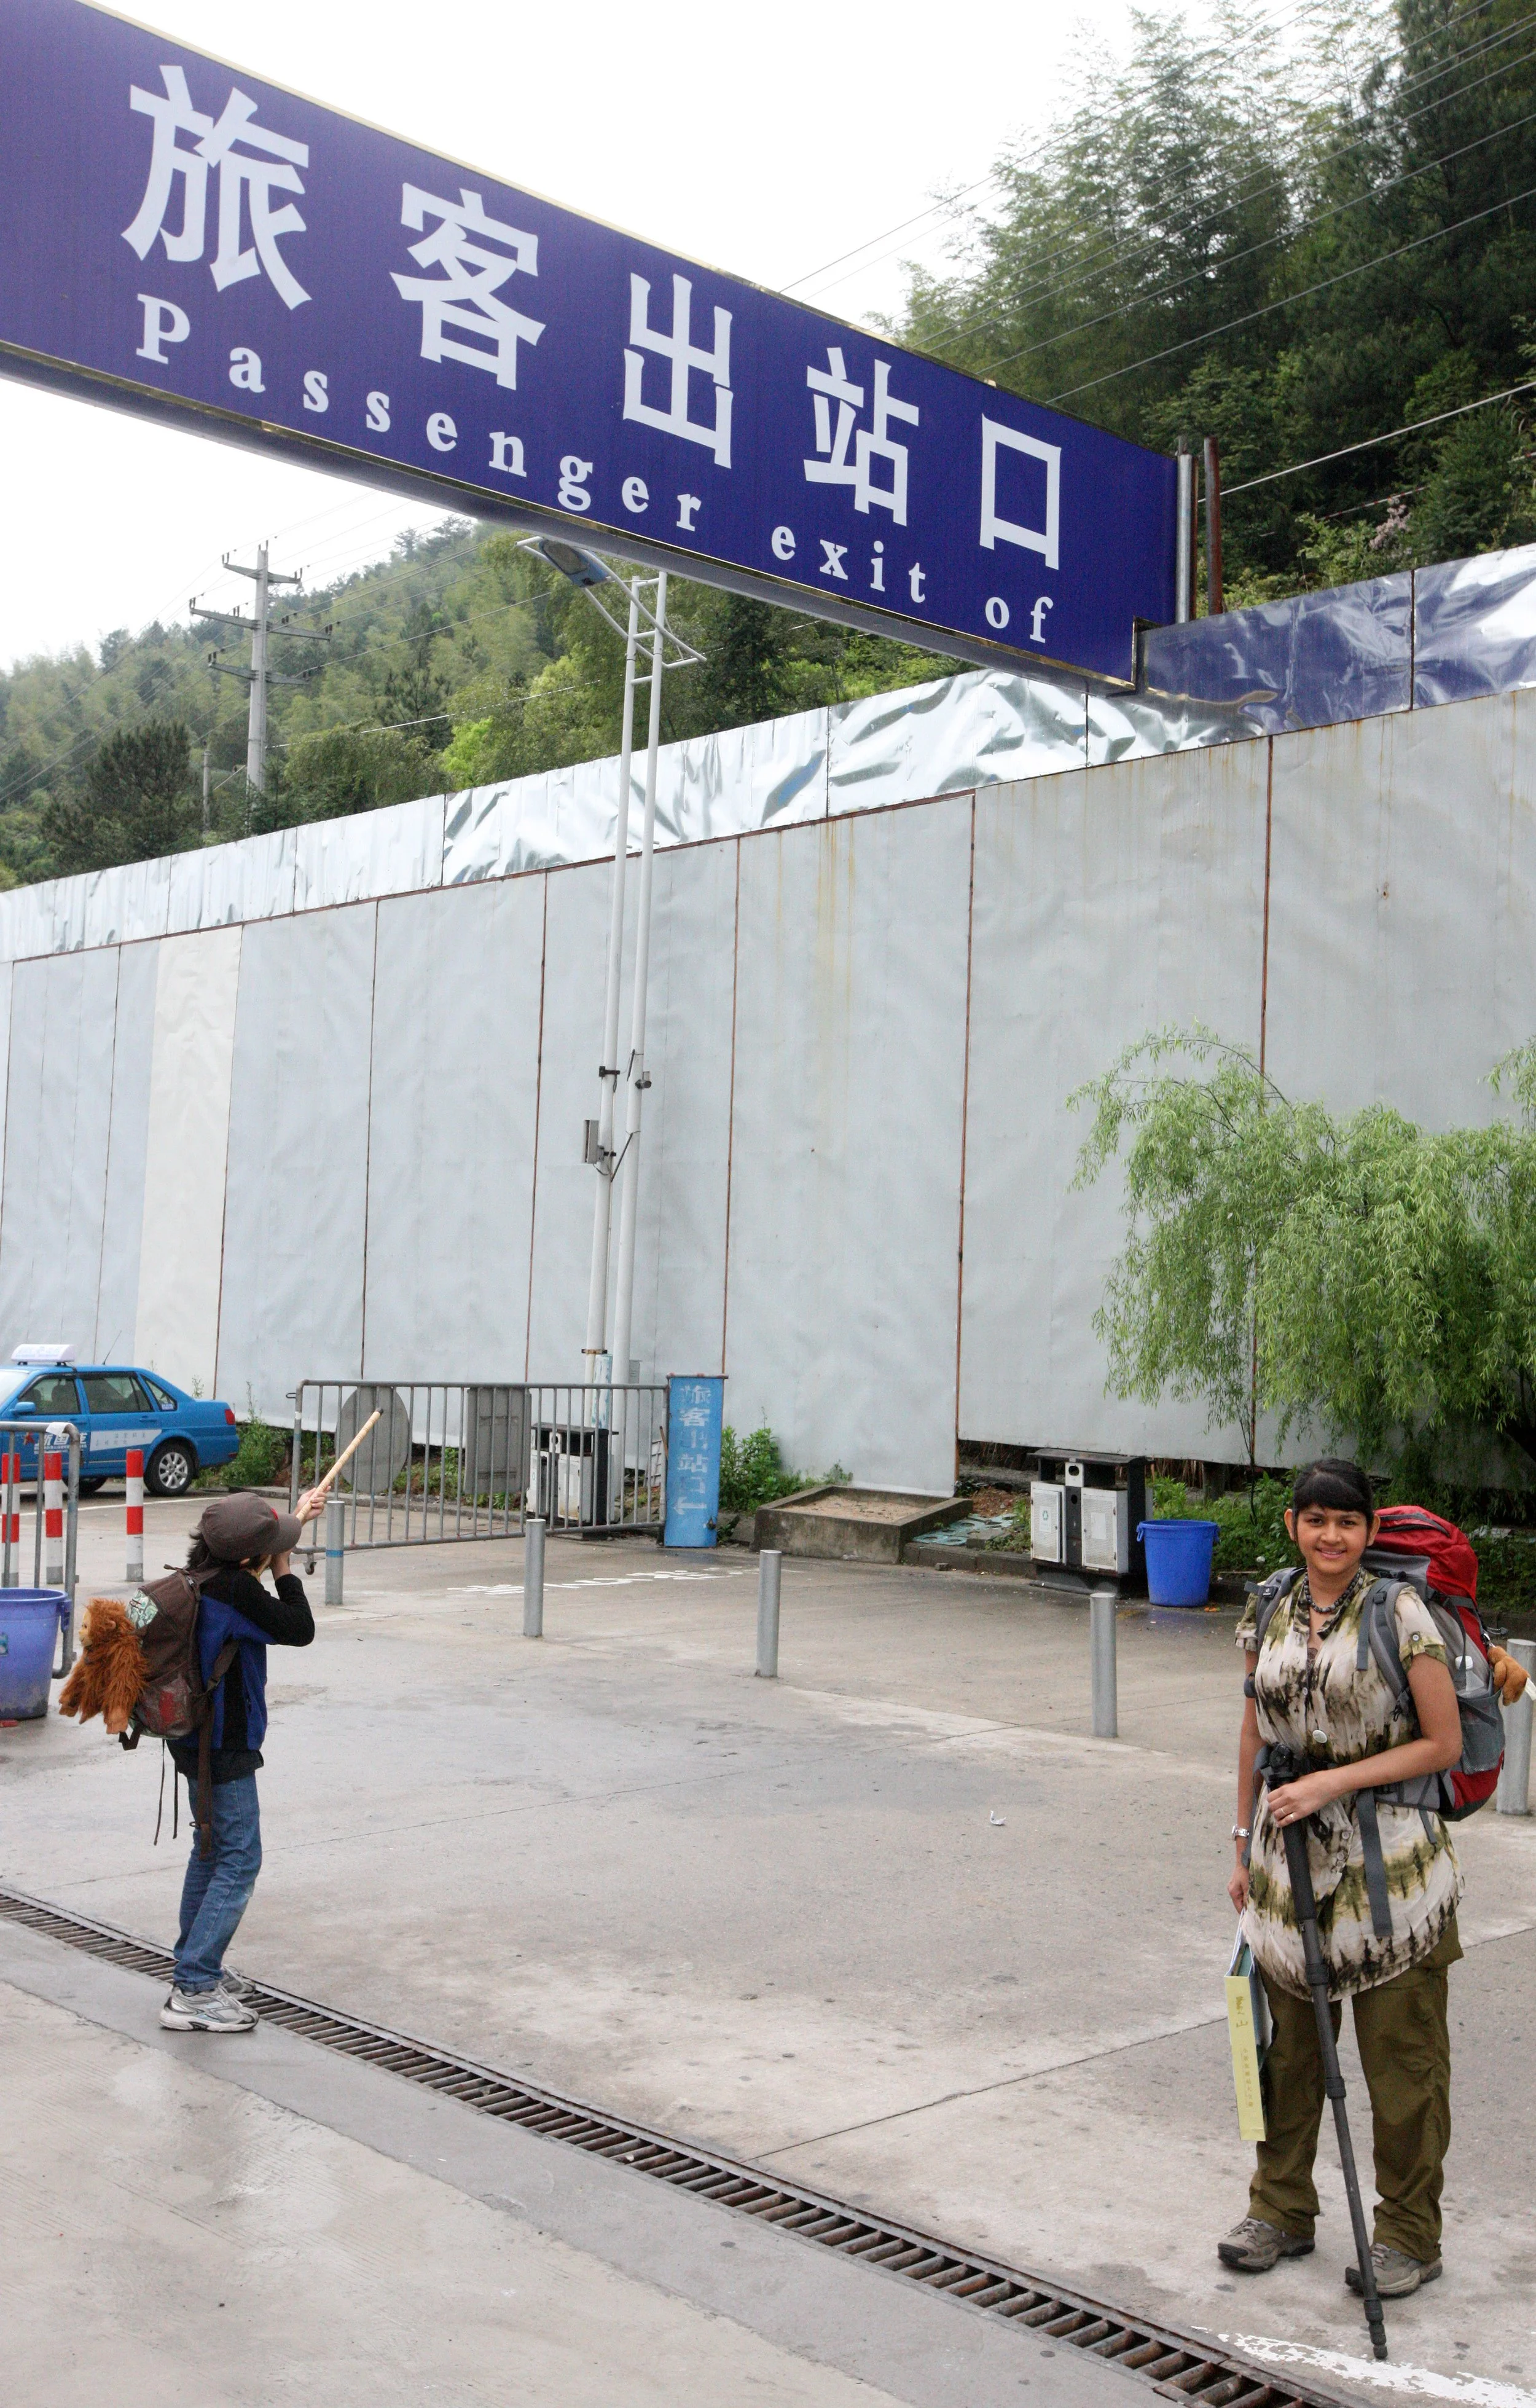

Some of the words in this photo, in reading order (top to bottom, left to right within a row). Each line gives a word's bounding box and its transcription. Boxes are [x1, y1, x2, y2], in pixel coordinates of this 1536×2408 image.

[121, 65, 1061, 570] 旅客出站口
[136, 294, 701, 531] Passenger
[771, 525, 926, 603] exit
[985, 596, 1054, 643] of
